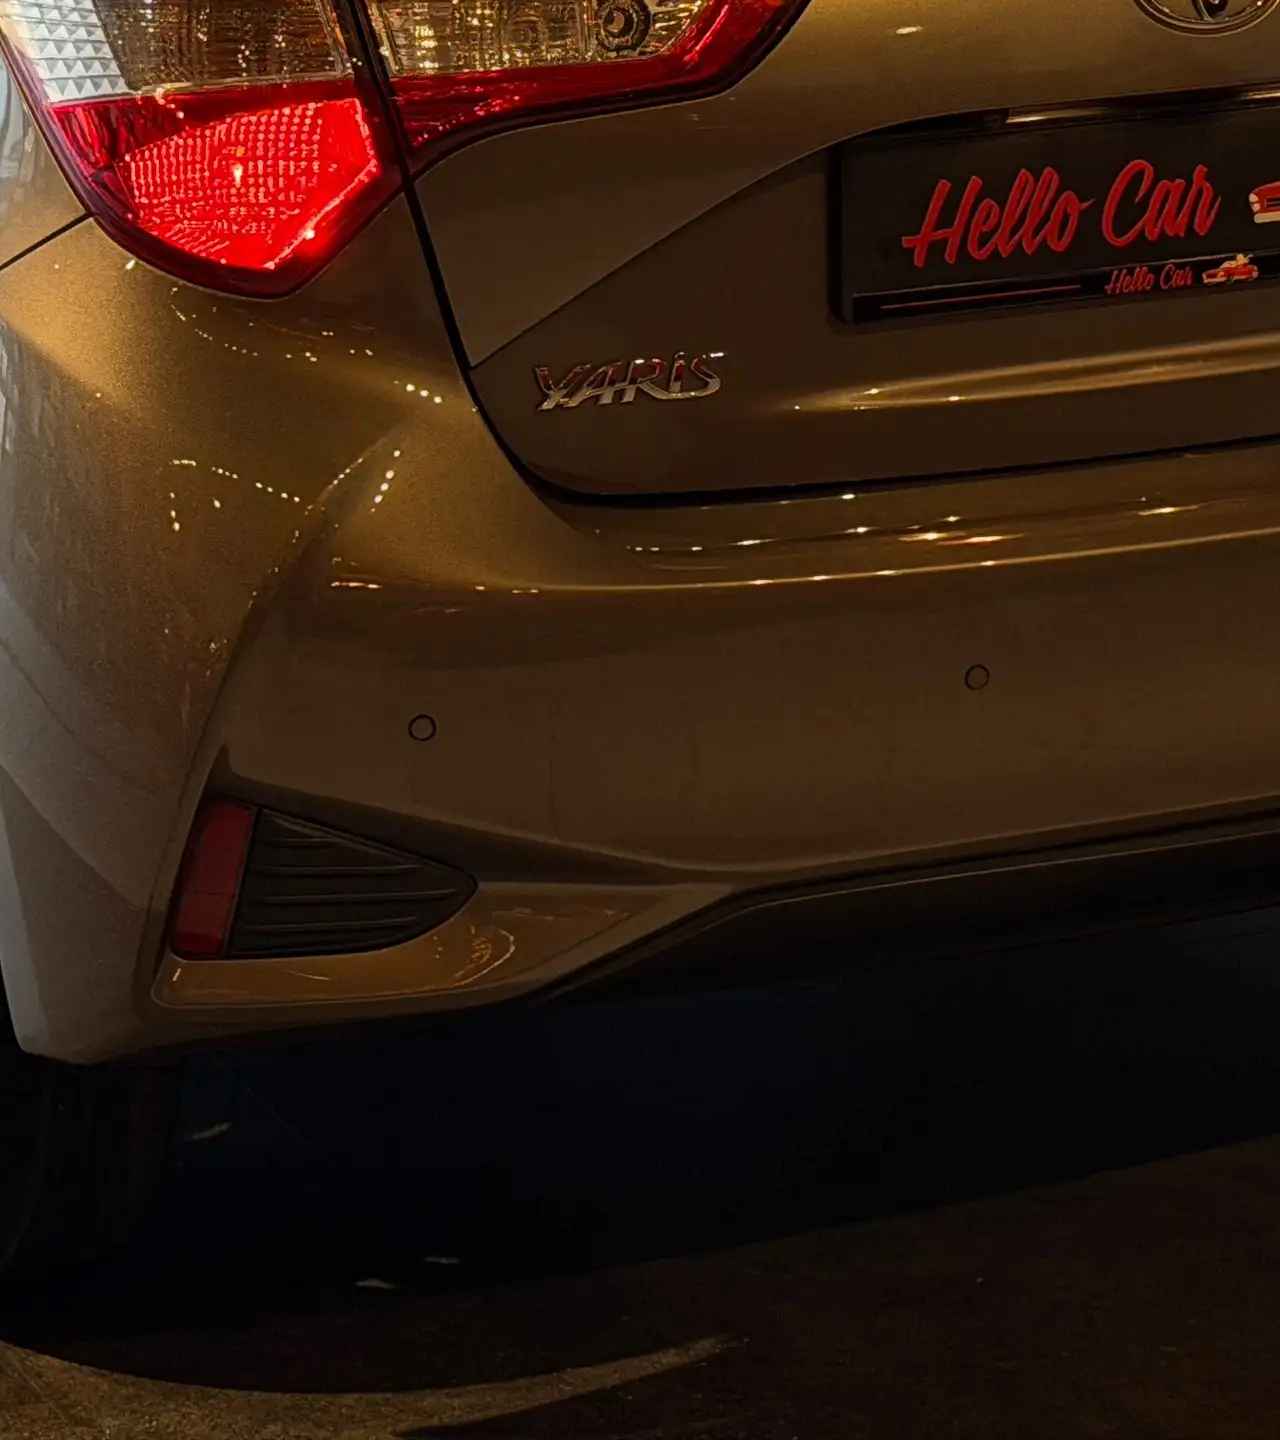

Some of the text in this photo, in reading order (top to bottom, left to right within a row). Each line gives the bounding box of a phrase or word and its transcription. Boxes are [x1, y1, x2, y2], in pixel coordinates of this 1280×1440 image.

[901, 159, 1221, 267] Hello Car
[1104, 263, 1194, 296] Hello Car
[534, 350, 726, 412] YARIS
